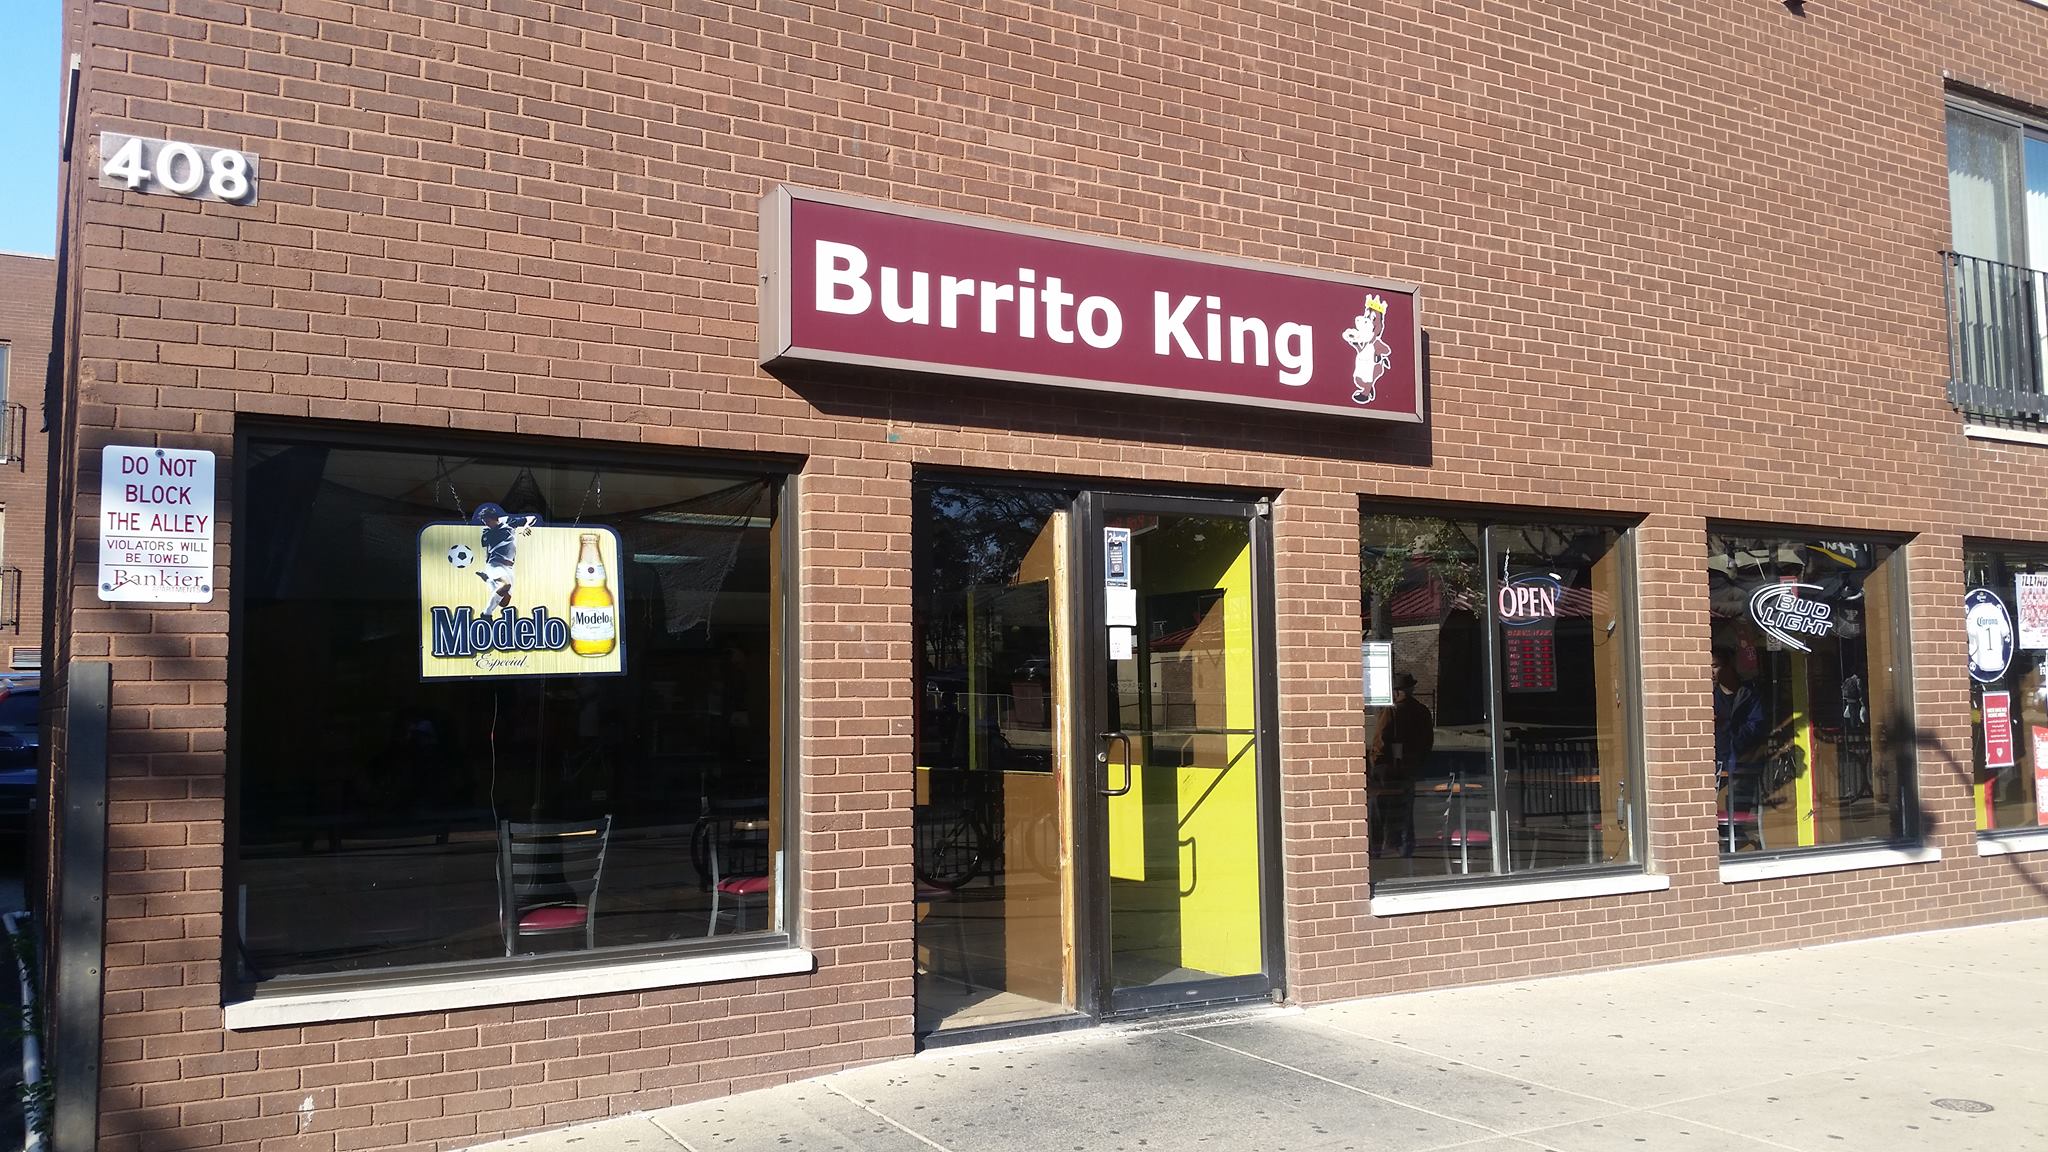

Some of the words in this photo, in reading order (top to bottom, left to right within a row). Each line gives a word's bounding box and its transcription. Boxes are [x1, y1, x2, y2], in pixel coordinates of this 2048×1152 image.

[103, 137, 250, 199] 408
[814, 239, 1122, 350] Burrito
[1153, 290, 1313, 386] King
[121, 455, 149, 475] DO
[159, 458, 197, 477] NOT
[125, 484, 192, 505] BLOCK
[107, 511, 141, 531] THE
[150, 513, 209, 533] ALLEY
[106, 539, 174, 551] VIOLATORS
[180, 541, 208, 553] WILL
[125, 553, 142, 563] BE
[148, 553, 189, 564] TOWED
[112, 569, 204, 588] Bankier
[1499, 586, 1555, 618] OPEN
[1776, 593, 1831, 620] BUD
[575, 611, 609, 625] Modelo
[1762, 606, 1833, 636] LIGHT
[1976, 616, 1998, 627] Corona
[432, 606, 570, 658] Modelo
[1985, 627, 1993, 651] 1
[474, 652, 529, 671] Especial
